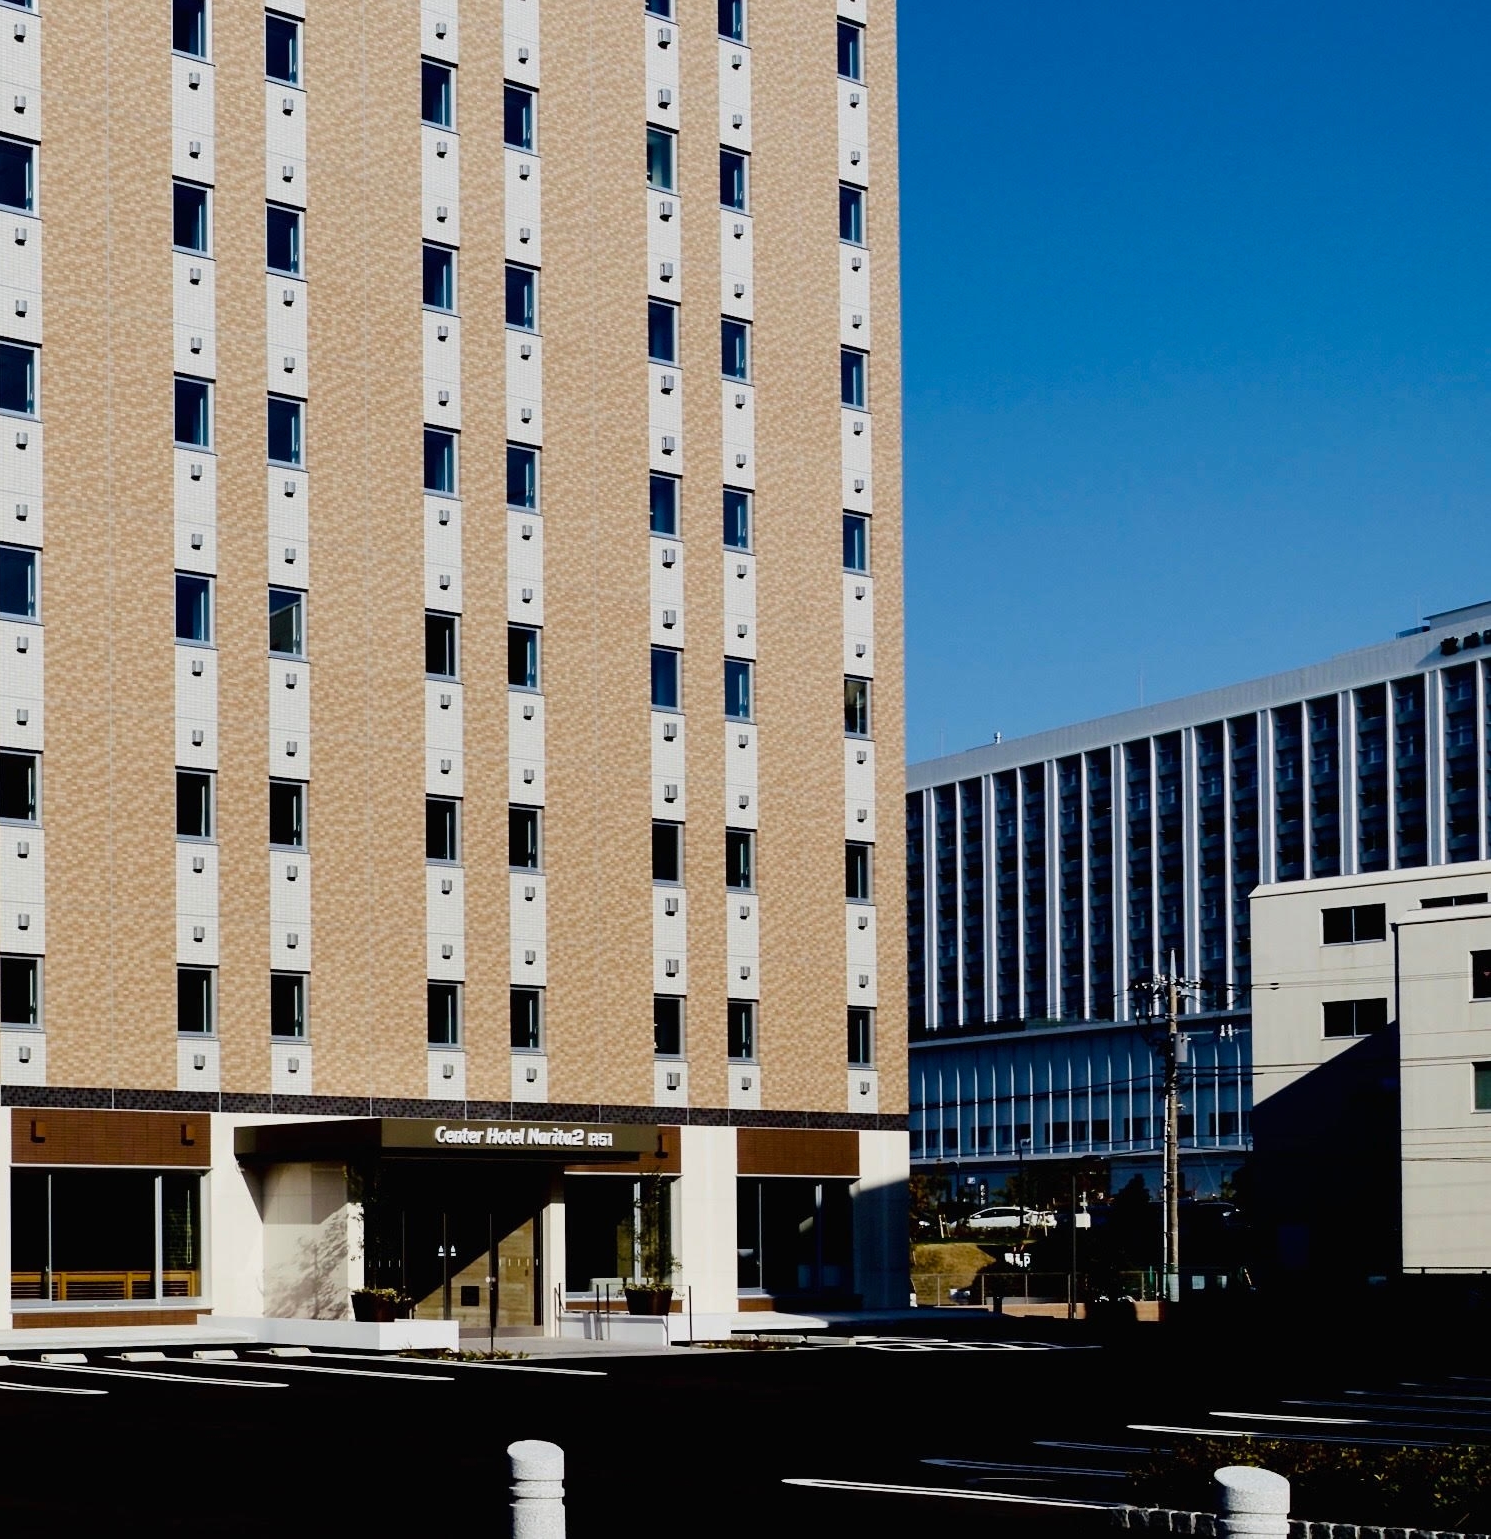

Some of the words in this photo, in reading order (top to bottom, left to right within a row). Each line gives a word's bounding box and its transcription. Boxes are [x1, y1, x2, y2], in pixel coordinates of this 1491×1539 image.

[434, 1126, 484, 1144] Center
[485, 1127, 525, 1146] Hotel
[527, 1127, 584, 1147] Narita2
[587, 1132, 613, 1147] R51
